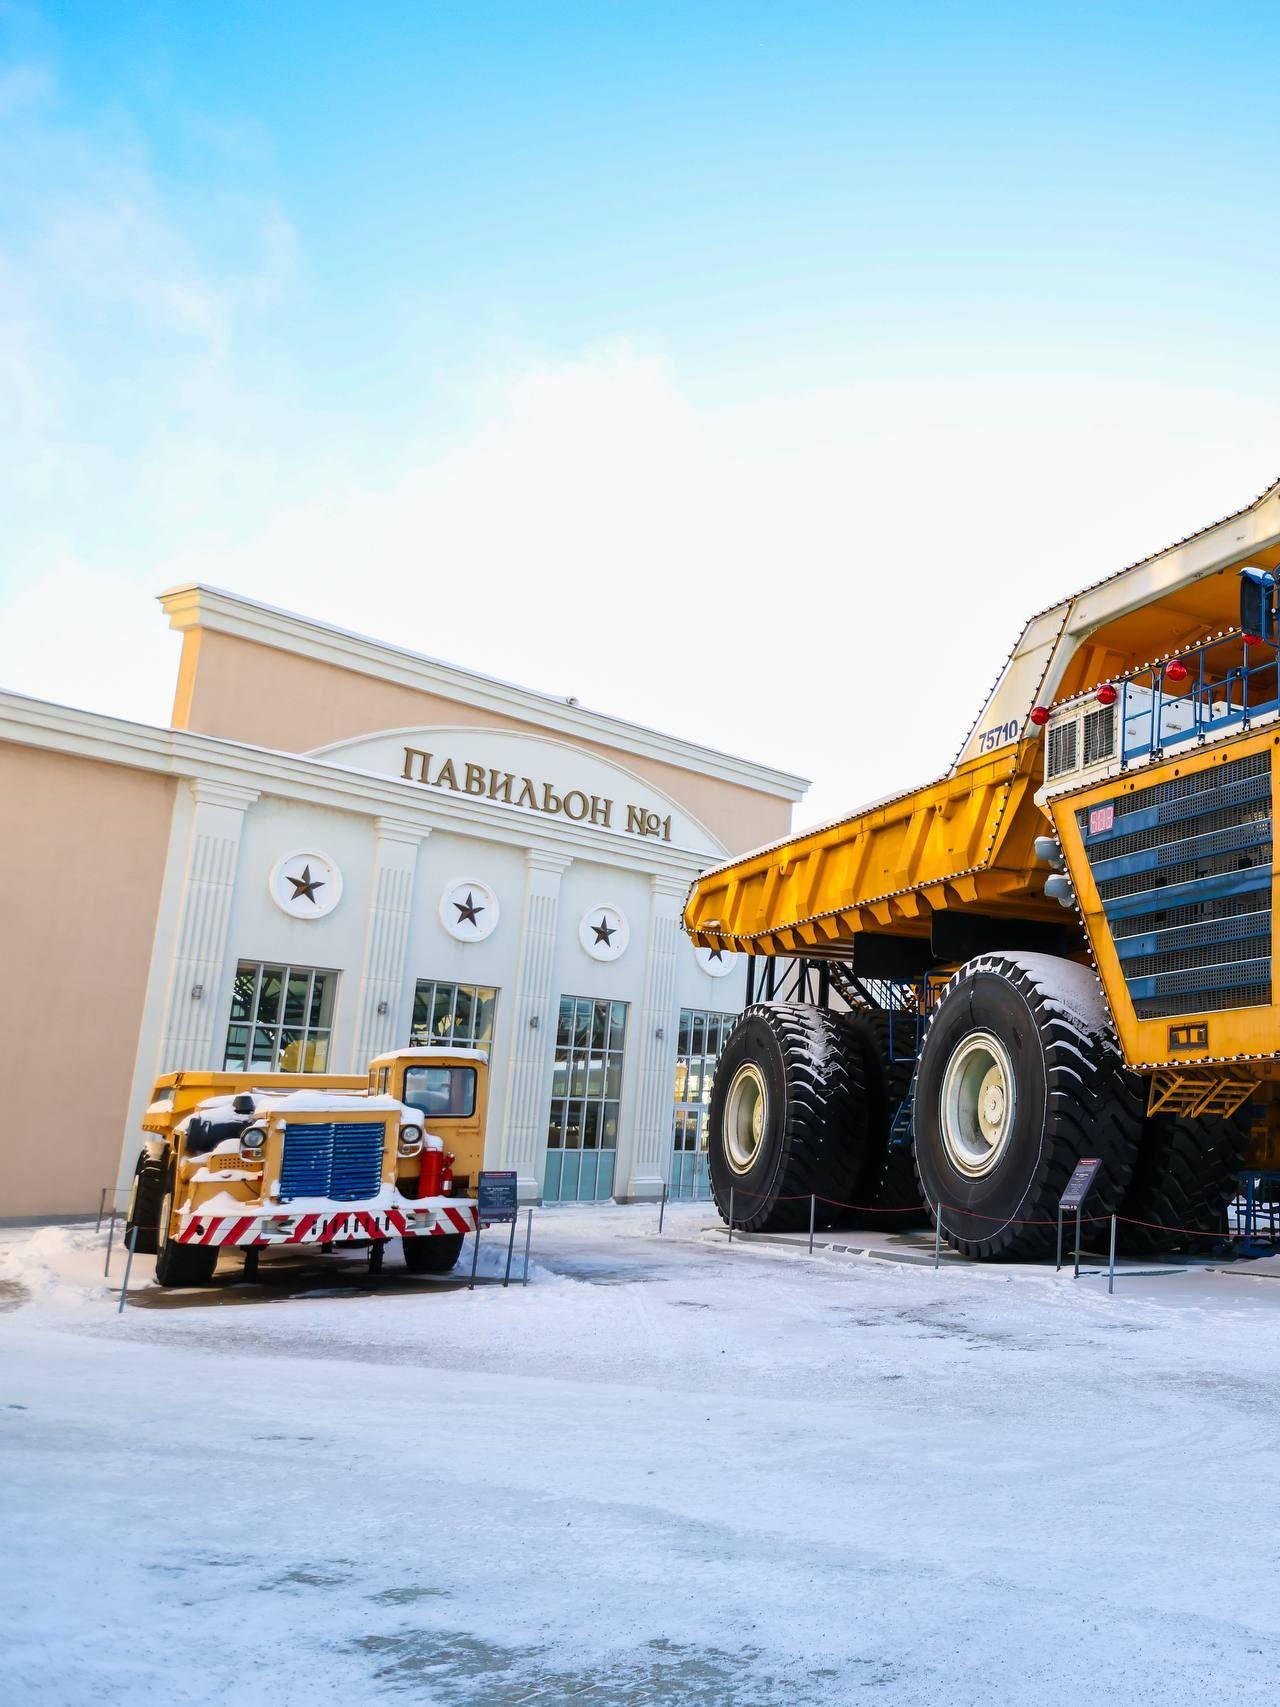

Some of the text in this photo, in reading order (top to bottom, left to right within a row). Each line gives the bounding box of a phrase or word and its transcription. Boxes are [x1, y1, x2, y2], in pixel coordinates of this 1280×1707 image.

[978, 719, 1019, 753] 75710
[400, 746, 672, 842] ПАВИЛЬОН №1
